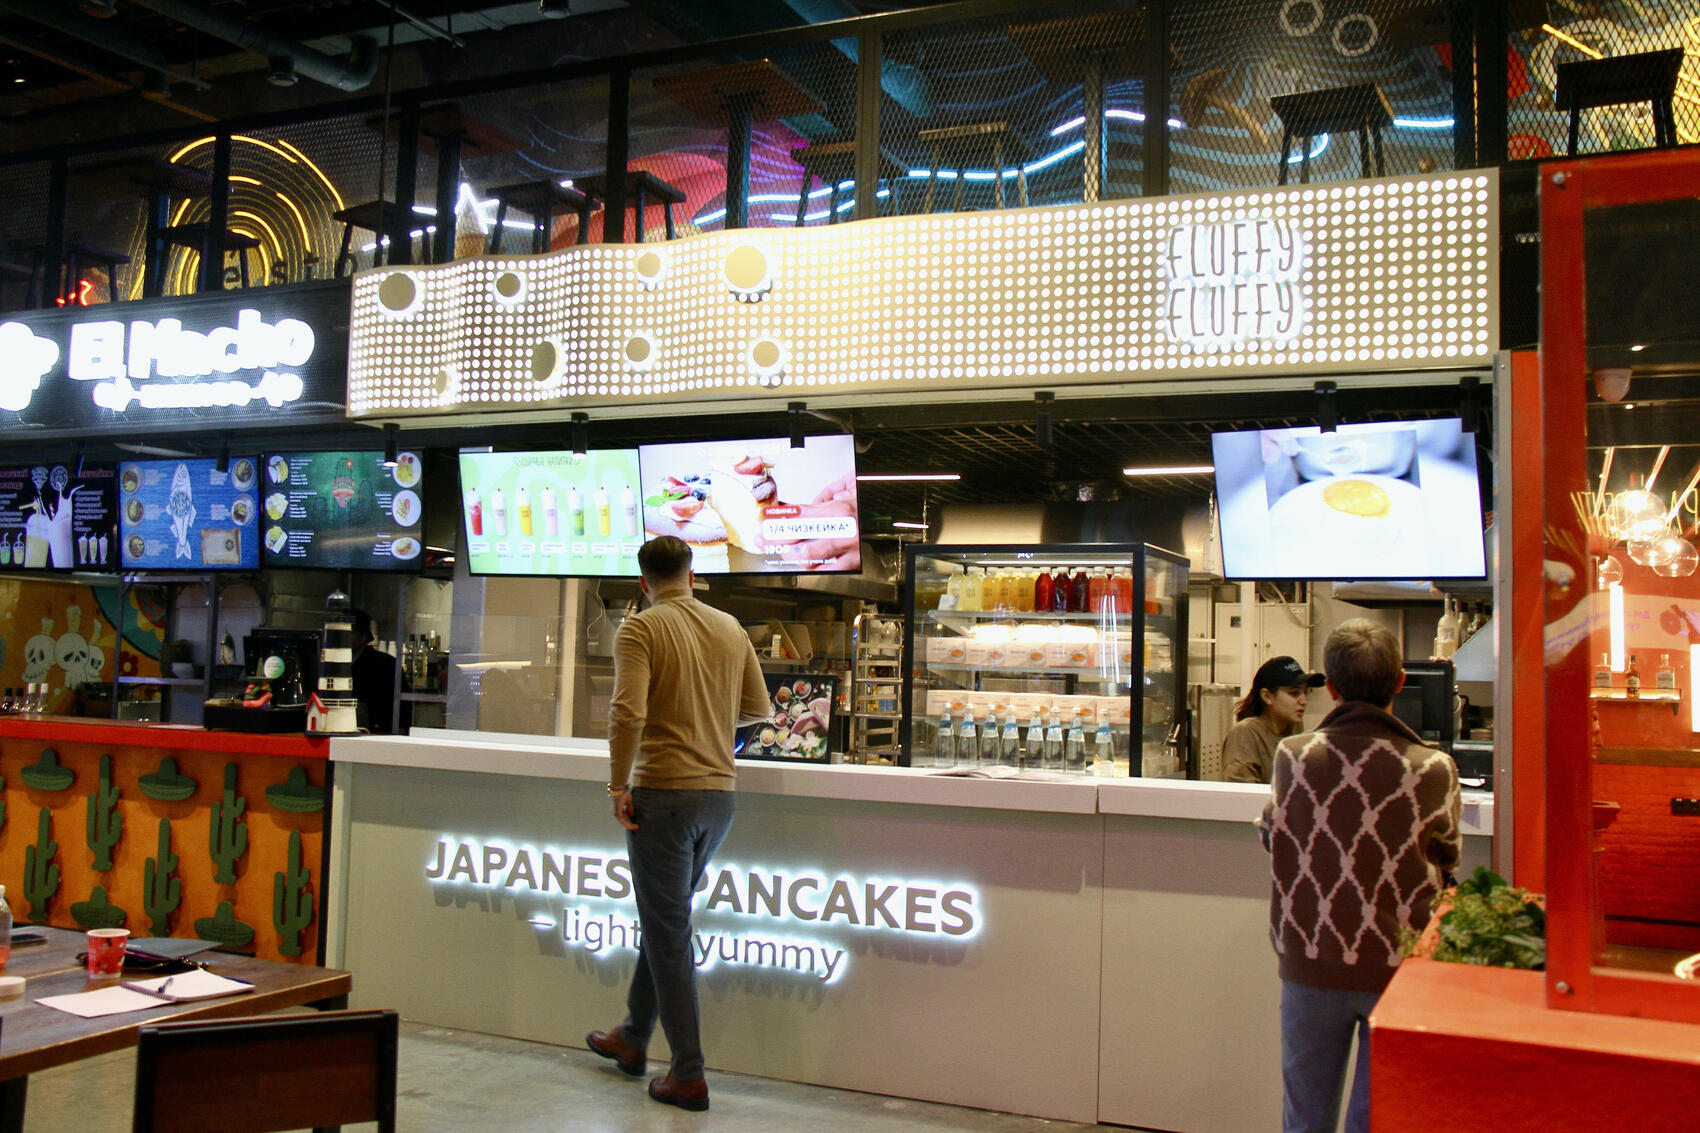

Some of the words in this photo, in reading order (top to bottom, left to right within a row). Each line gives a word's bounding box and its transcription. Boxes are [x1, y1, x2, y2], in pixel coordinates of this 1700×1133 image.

[1166, 220, 1294, 278] FLUFFY
[1167, 281, 1294, 338] FLUFFY
[766, 507, 798, 515] НОВИНКА
[426, 841, 631, 899] JAPANES
[563, 908, 641, 952] light
[695, 933, 844, 982] yummy
